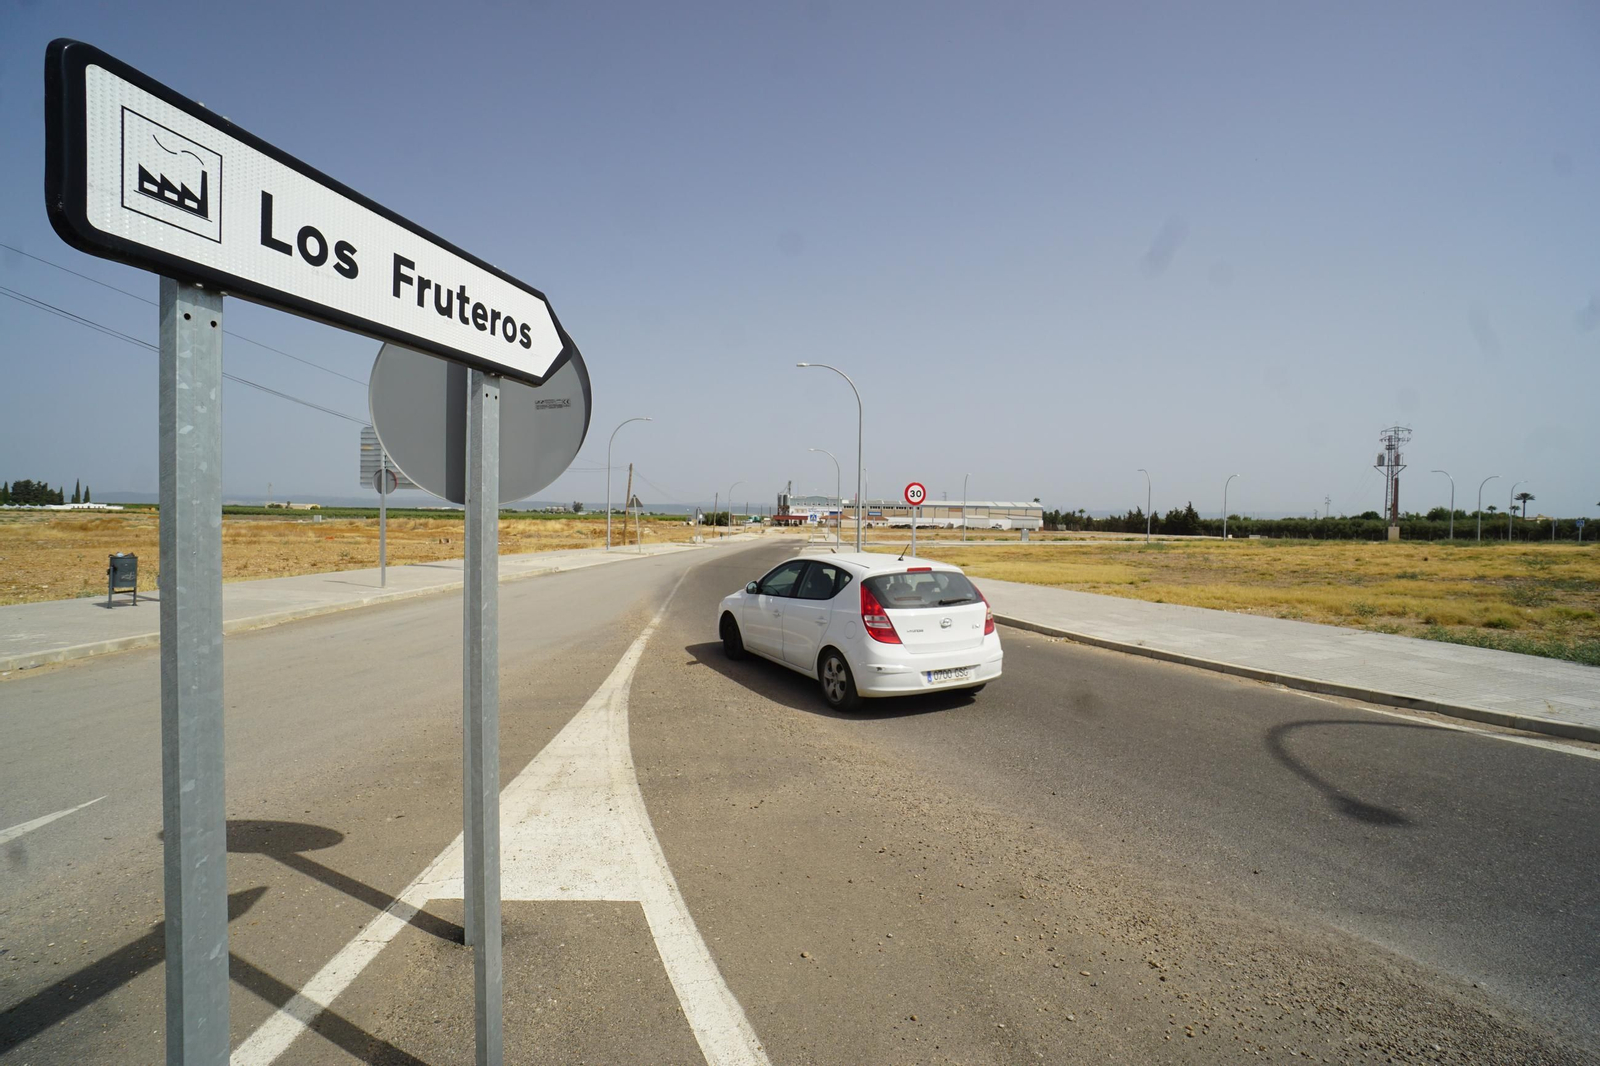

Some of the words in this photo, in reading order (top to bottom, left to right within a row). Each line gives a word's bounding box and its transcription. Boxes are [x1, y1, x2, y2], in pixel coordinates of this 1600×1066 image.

[260, 189, 359, 280] Los
[392, 252, 532, 350] Fruteros
[909, 489, 922, 498] 30
[933, 669, 953, 681] 0700
